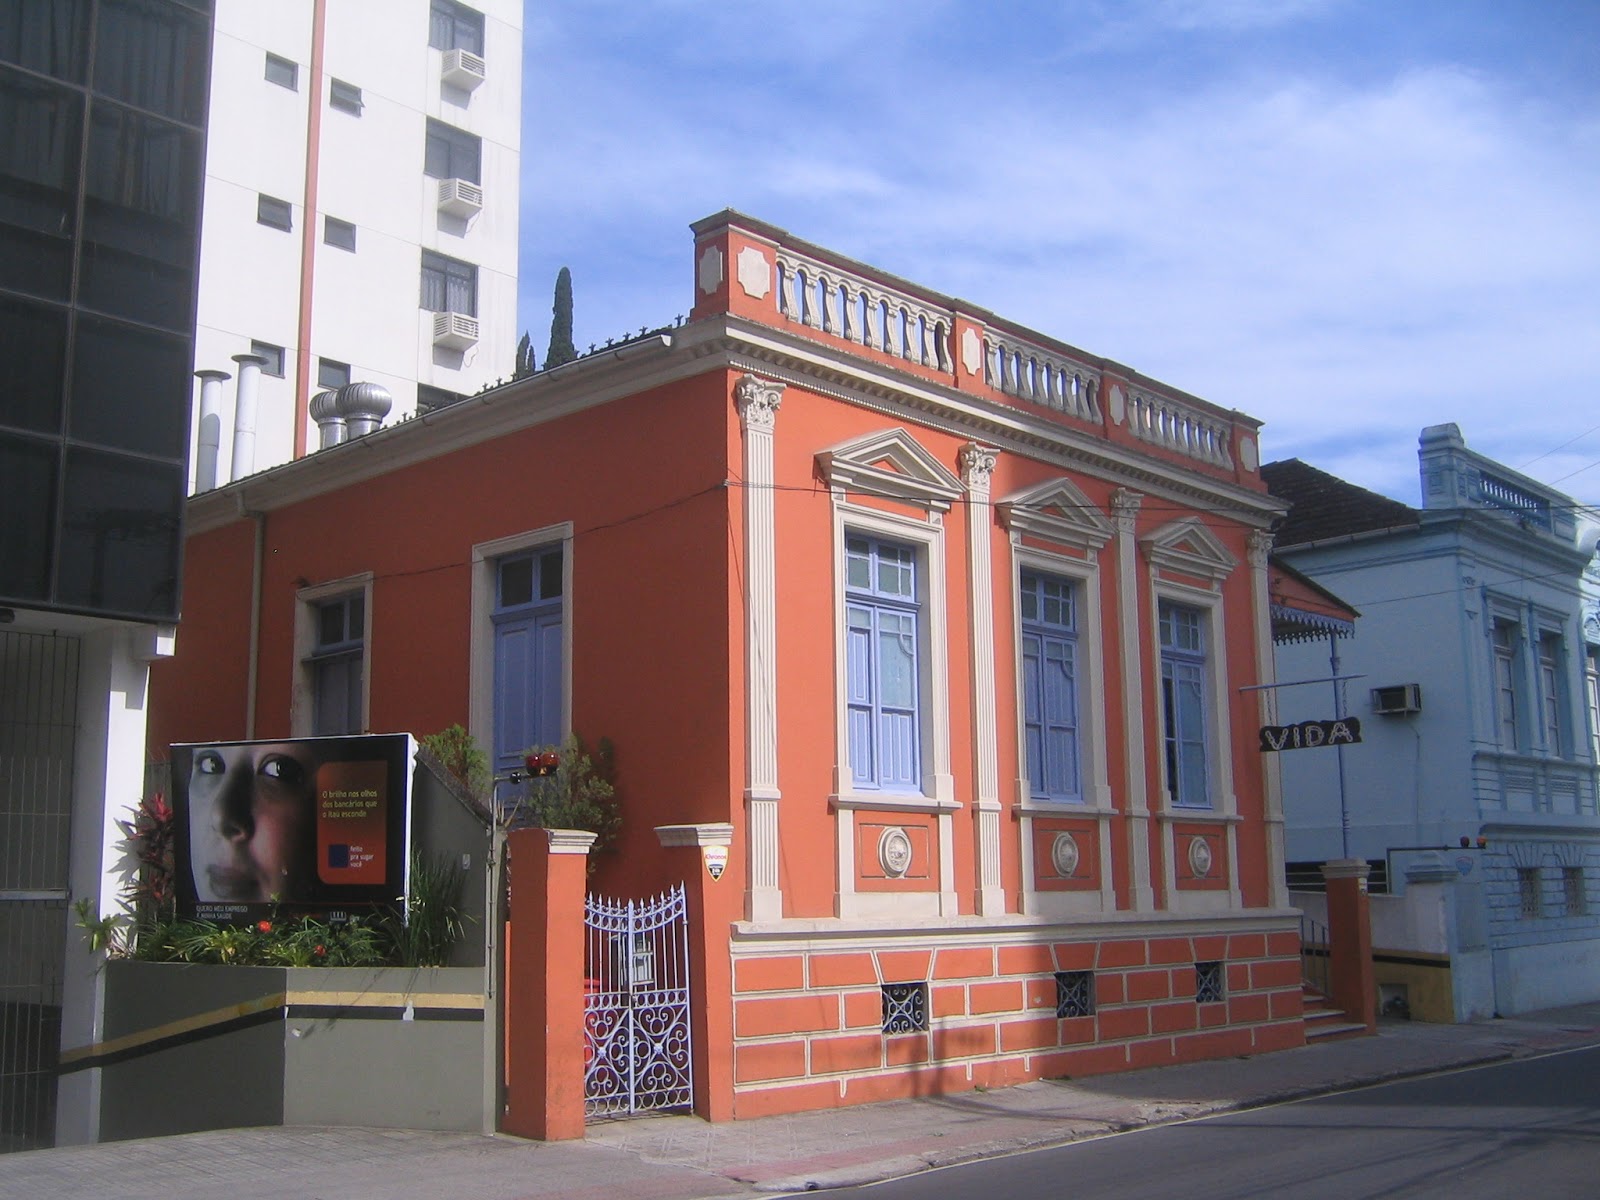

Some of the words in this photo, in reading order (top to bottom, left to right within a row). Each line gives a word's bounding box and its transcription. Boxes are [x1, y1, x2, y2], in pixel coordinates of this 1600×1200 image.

[1265, 722, 1353, 750] VIDA
[322, 790, 328, 798] O
[360, 789, 378, 798] olhos
